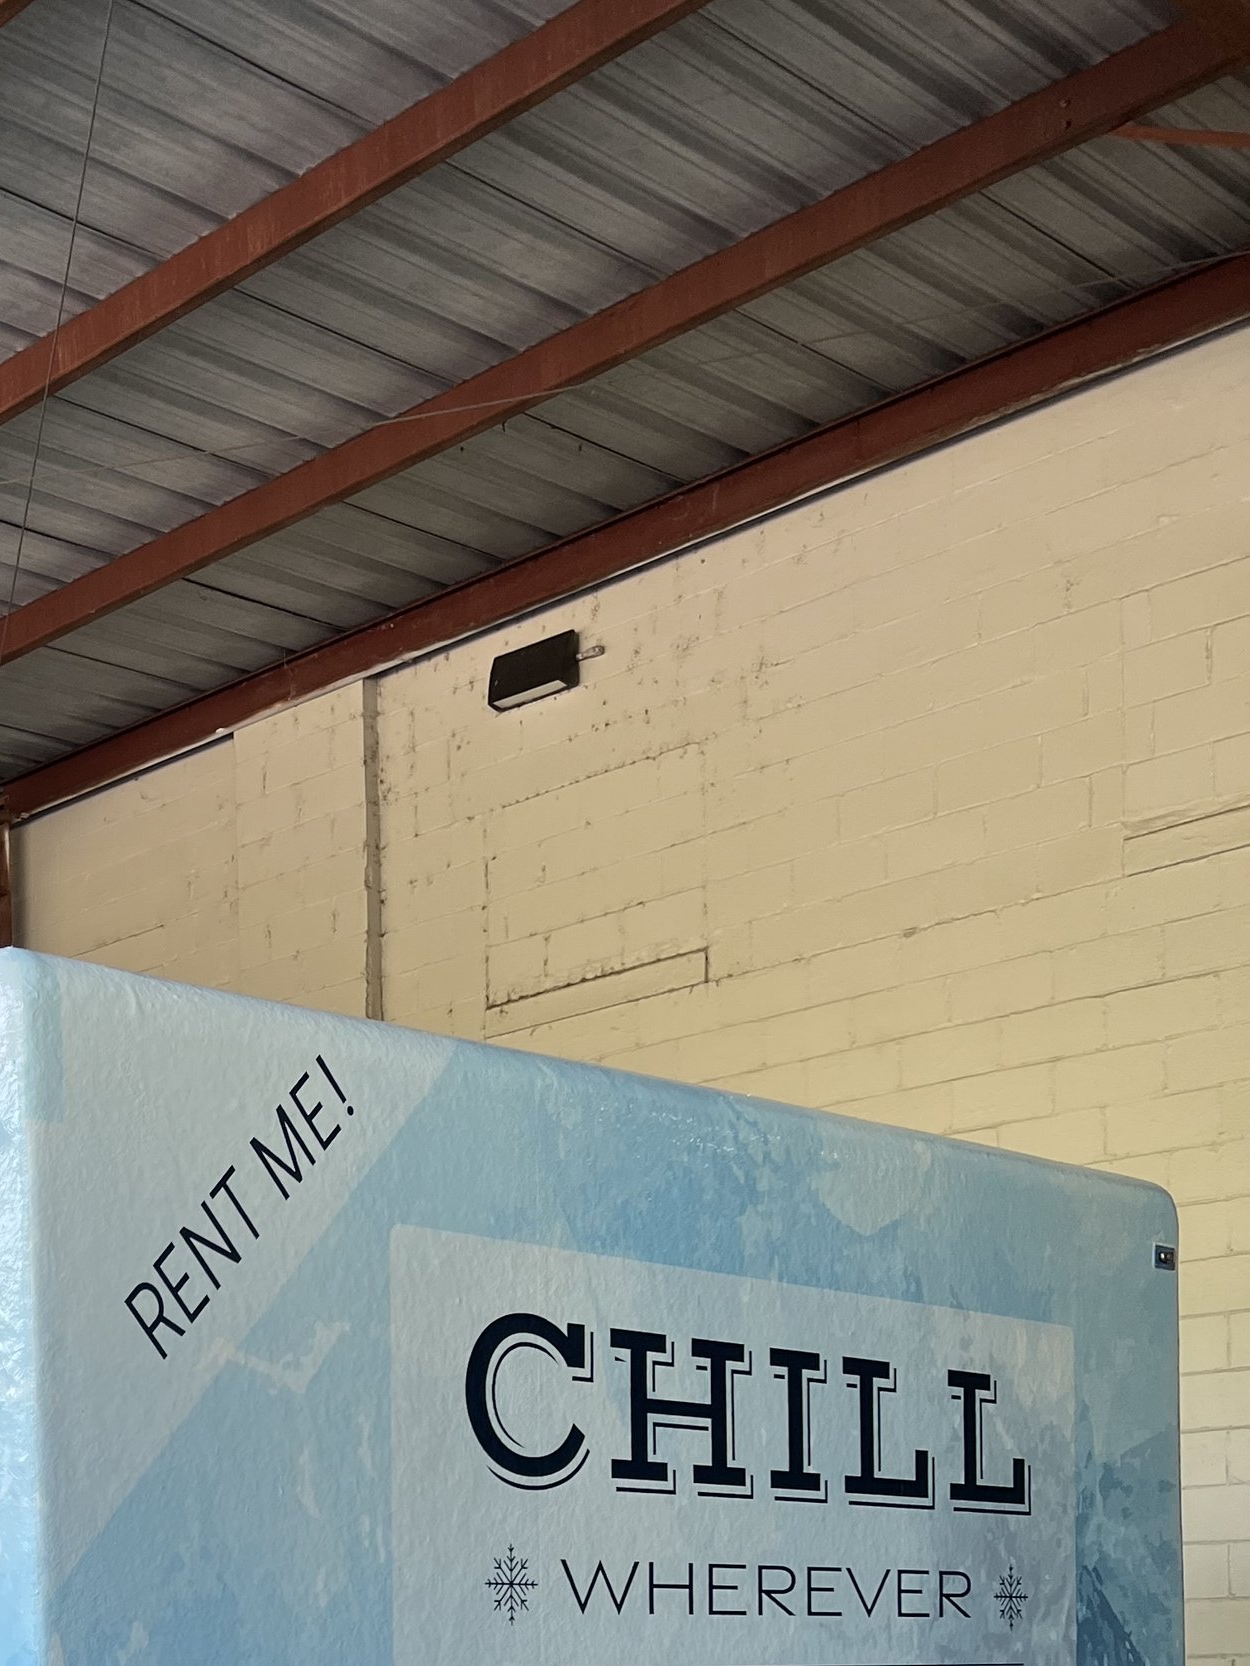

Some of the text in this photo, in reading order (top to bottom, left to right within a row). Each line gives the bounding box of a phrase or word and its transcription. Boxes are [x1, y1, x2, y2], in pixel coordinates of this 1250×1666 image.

[124, 1054, 354, 1360] RENT ME!
[465, 1312, 1032, 1515] CHILL
[560, 1558, 972, 1619] WHEREVER
